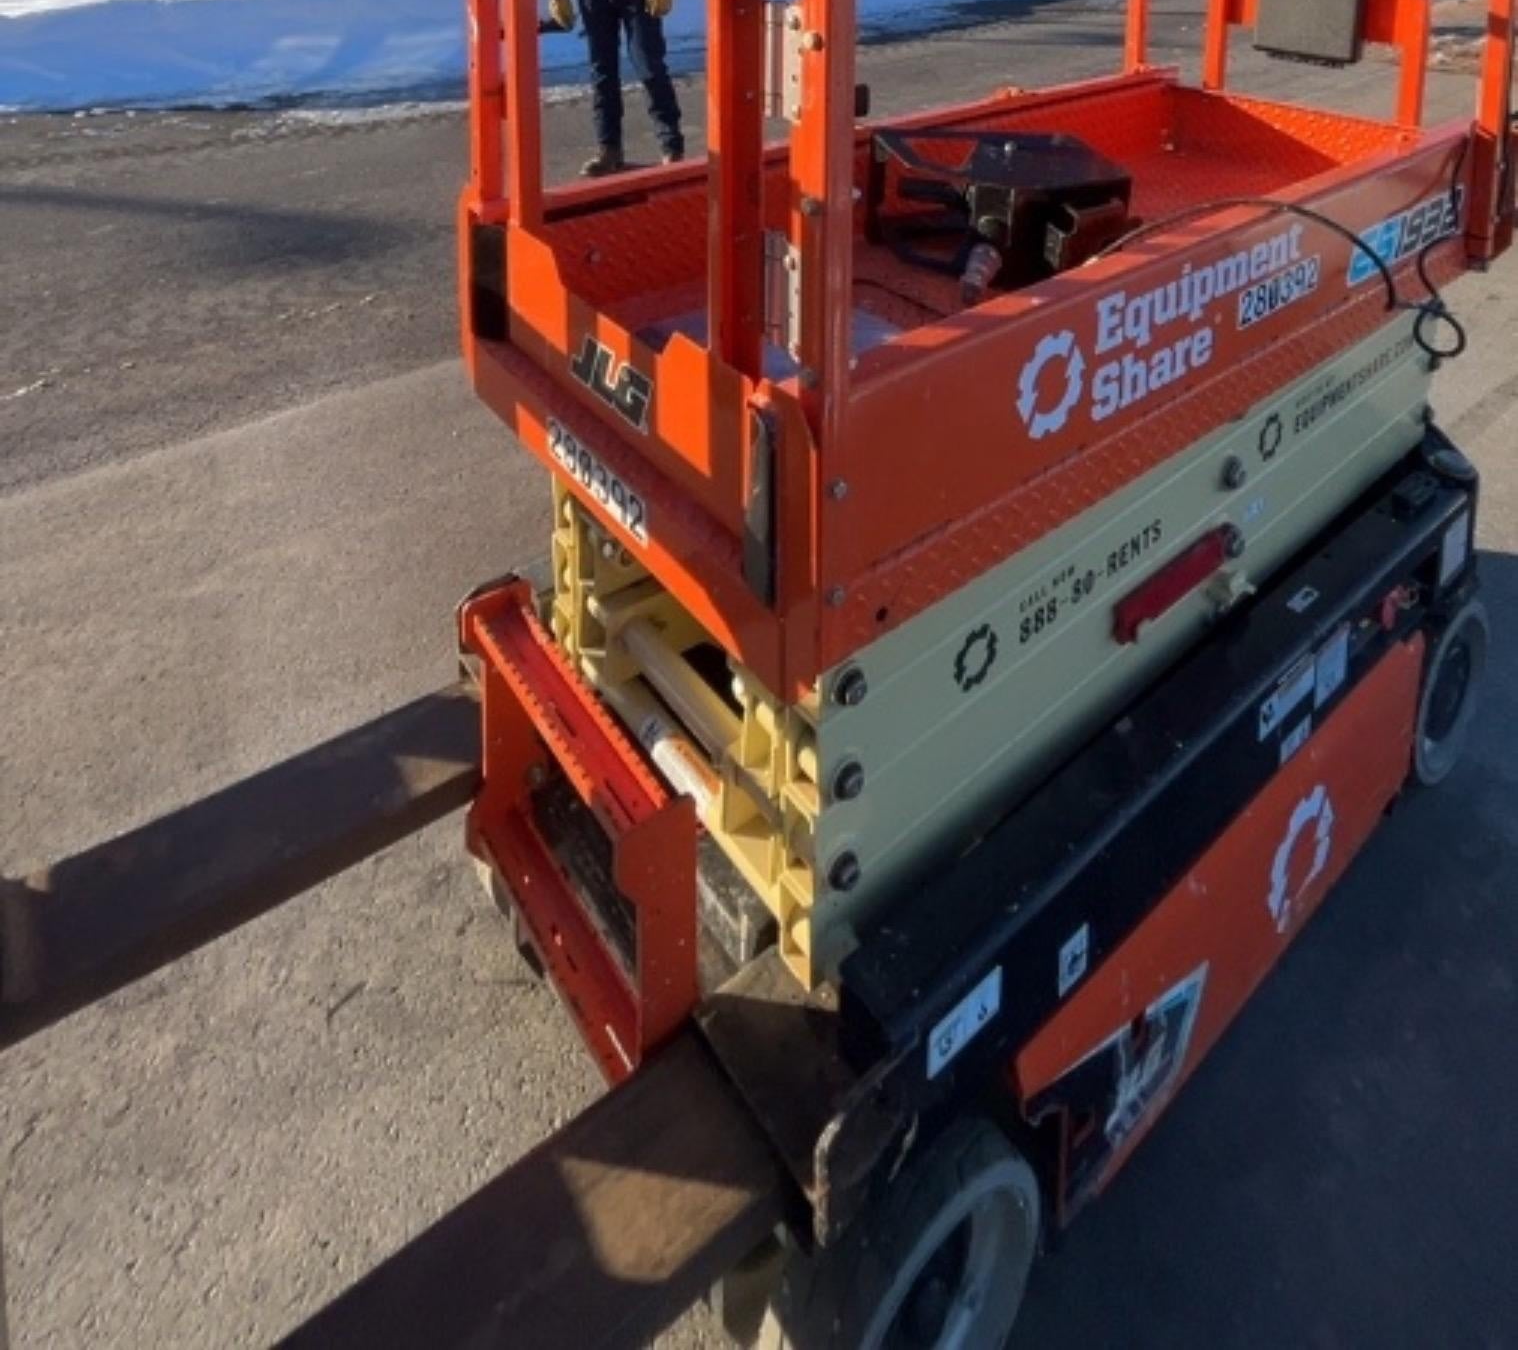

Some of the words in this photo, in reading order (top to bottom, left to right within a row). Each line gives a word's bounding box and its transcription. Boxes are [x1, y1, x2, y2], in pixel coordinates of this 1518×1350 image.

[1095, 222, 1304, 354] Equipment
[1240, 258, 1319, 326] 280392
[571, 335, 653, 434] JLG
[1092, 326, 1213, 421] Share
[1019, 518, 1162, 644] 888-80-RENTS
